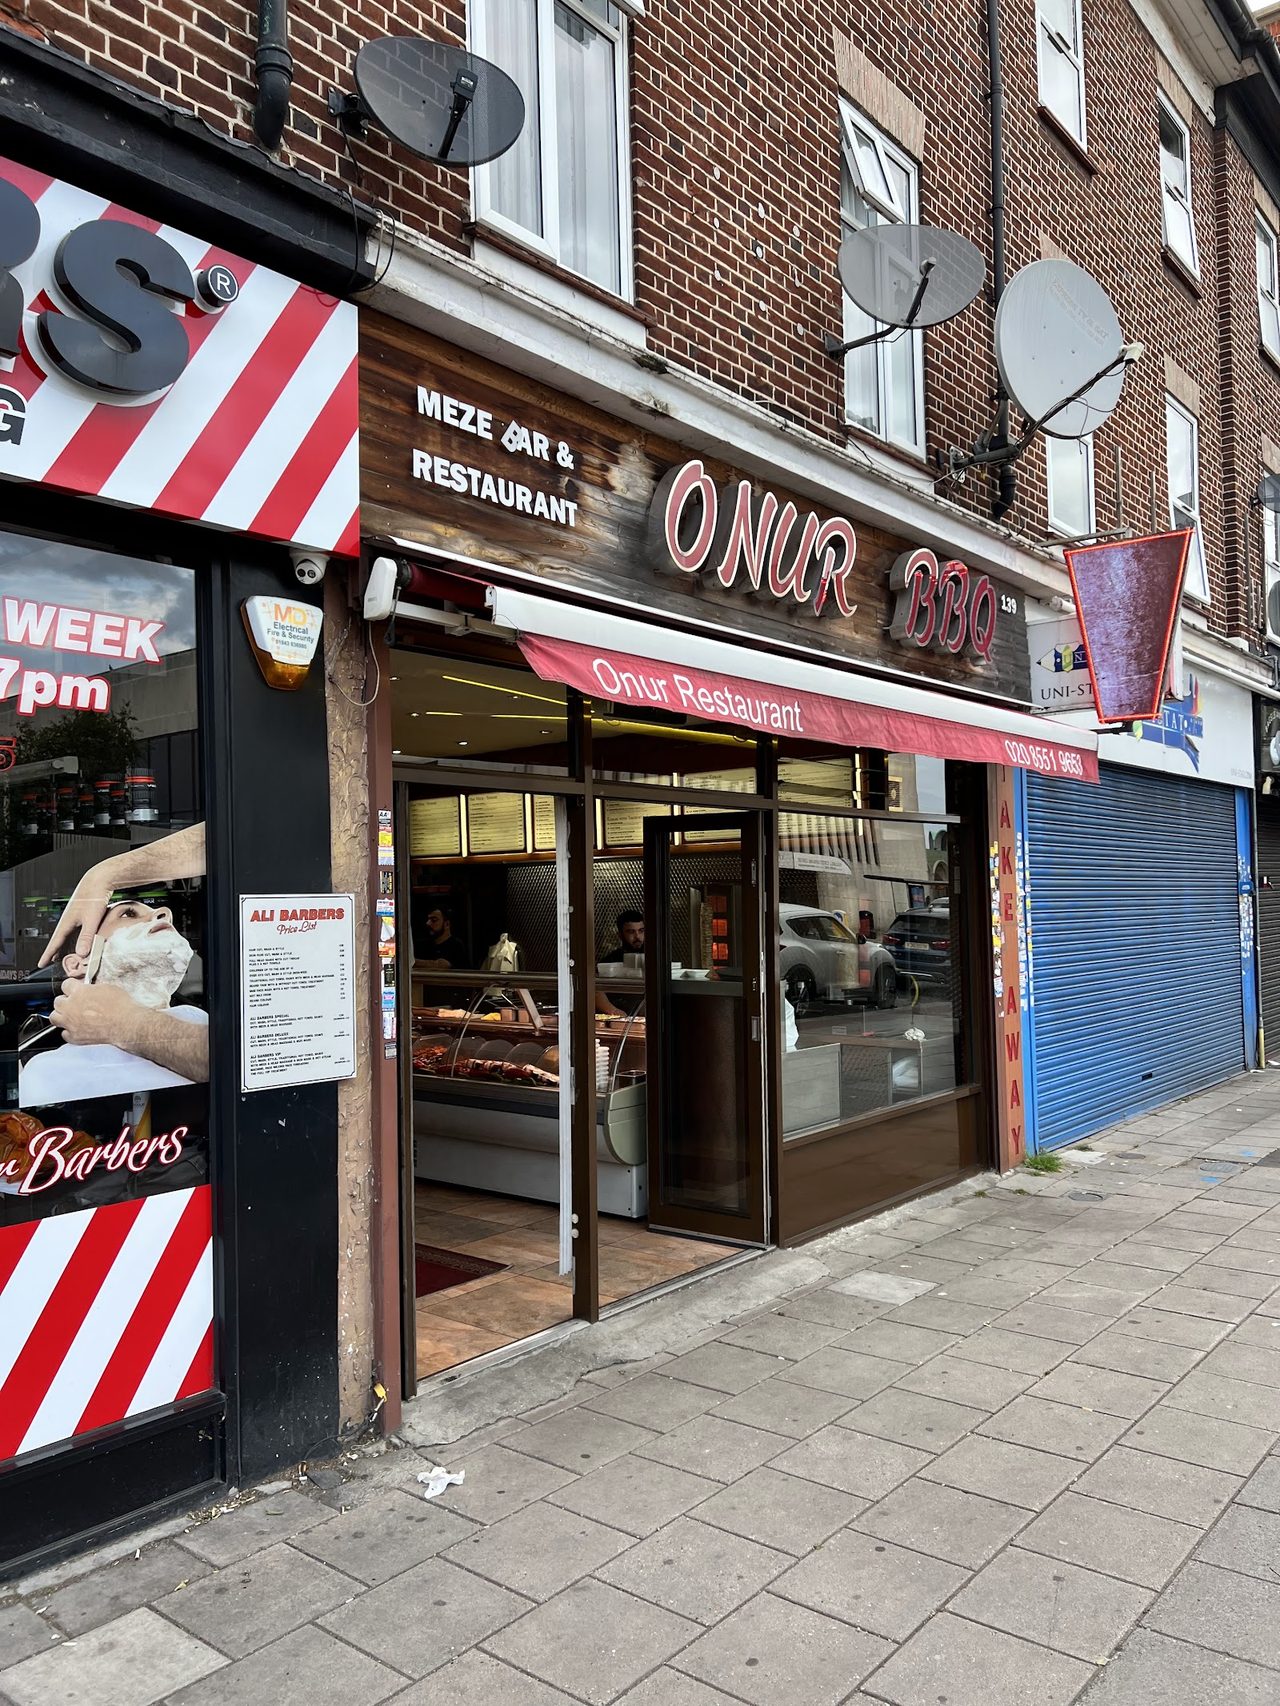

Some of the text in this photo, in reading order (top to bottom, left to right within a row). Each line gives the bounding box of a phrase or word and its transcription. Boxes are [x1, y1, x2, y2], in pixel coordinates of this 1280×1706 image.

[417, 385, 574, 470] MEZE BAR &
[412, 448, 578, 527] RESTAURANT
[664, 459, 997, 664] ONUR BBQ
[273, 603, 308, 626] MD
[273, 621, 309, 635] Electrical
[1001, 594, 1017, 614] 139
[4, 598, 165, 664] WEEK
[267, 628, 280, 637] Fire
[288, 632, 315, 645] Security
[592, 658, 804, 732] Onur Restaurant
[1004, 740, 1084, 776] 020 8551 9653
[250, 907, 345, 922] ALI BARBERS
[276, 920, 317, 935] Price List
[1005, 985, 1022, 1155] AWAY
[18, 1125, 189, 1196] Barbers
